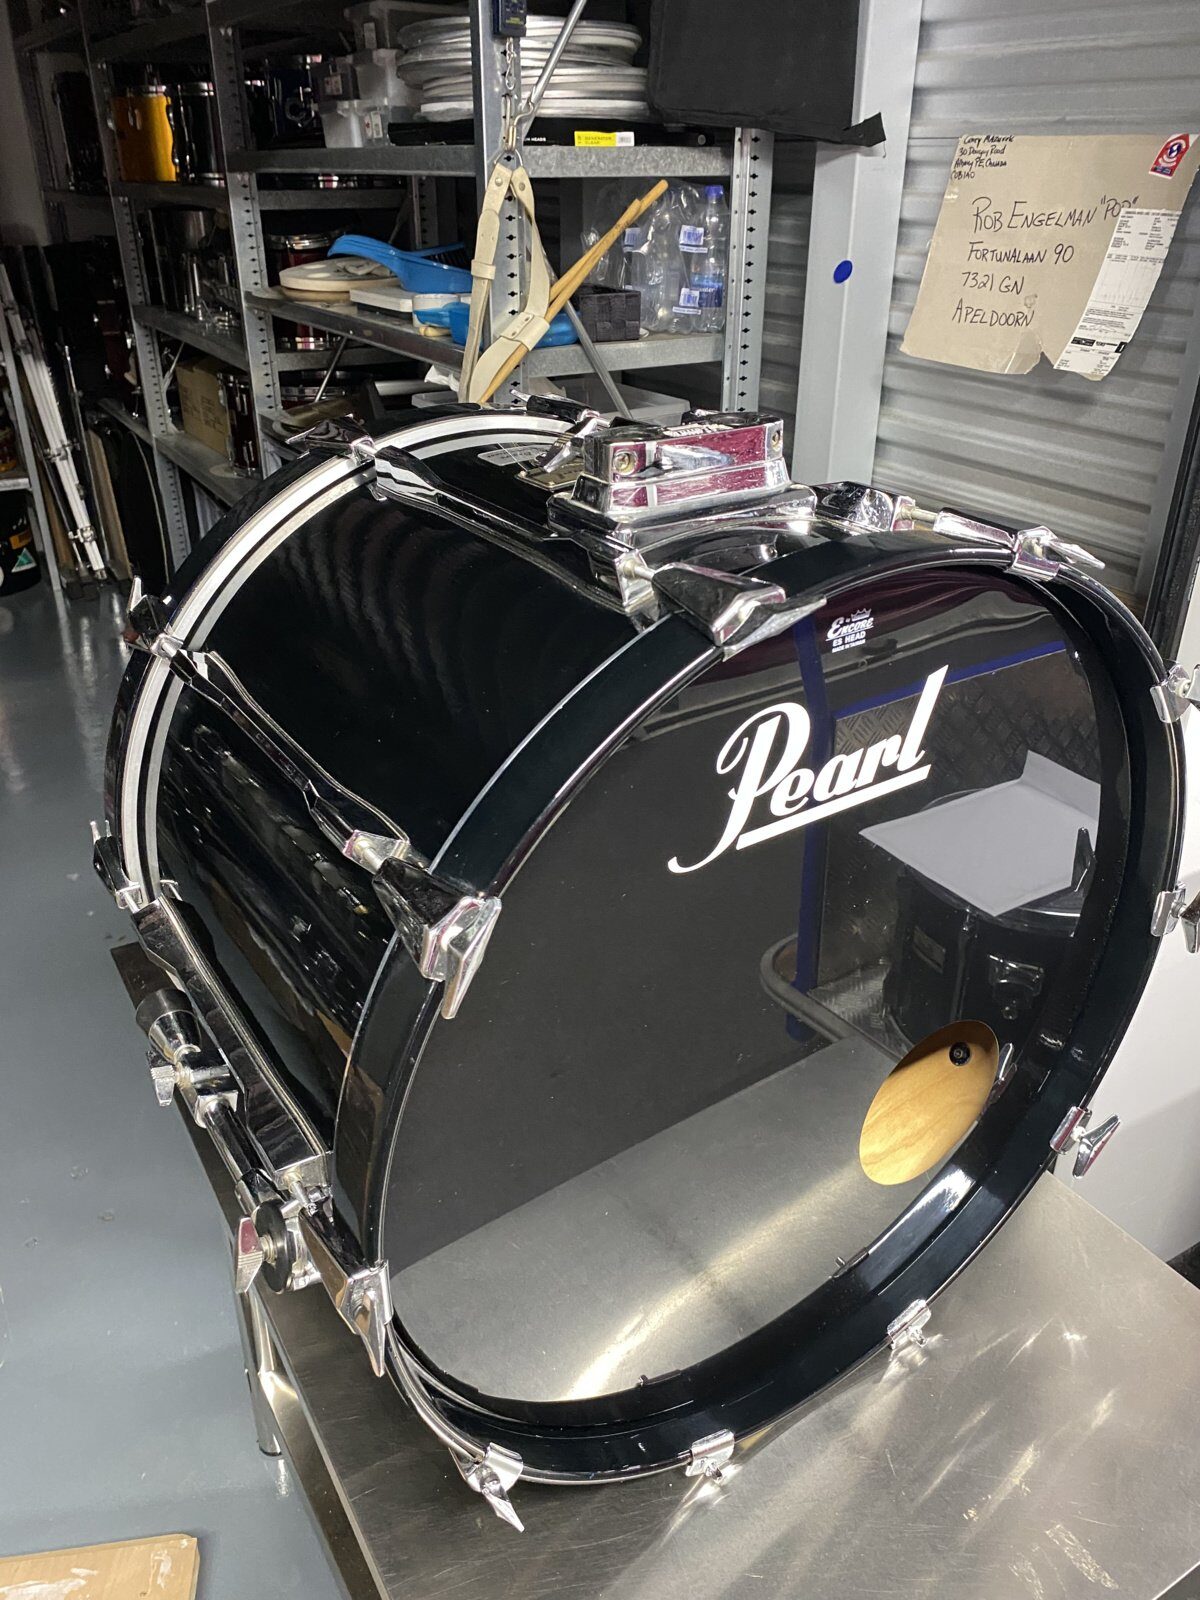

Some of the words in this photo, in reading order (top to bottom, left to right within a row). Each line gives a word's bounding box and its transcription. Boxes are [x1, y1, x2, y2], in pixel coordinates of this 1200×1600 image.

[1007, 200, 1098, 229] ENGELMAN
[967, 241, 1047, 264] FORTUNALAAN
[1053, 243, 1075, 265] 90
[961, 271, 994, 292] 7321
[998, 275, 1025, 295] GN
[951, 297, 1035, 327] APELDOORN
[832, 637, 843, 647] ES
[844, 630, 866, 643] HEAD
[667, 664, 949, 874] Pearl
